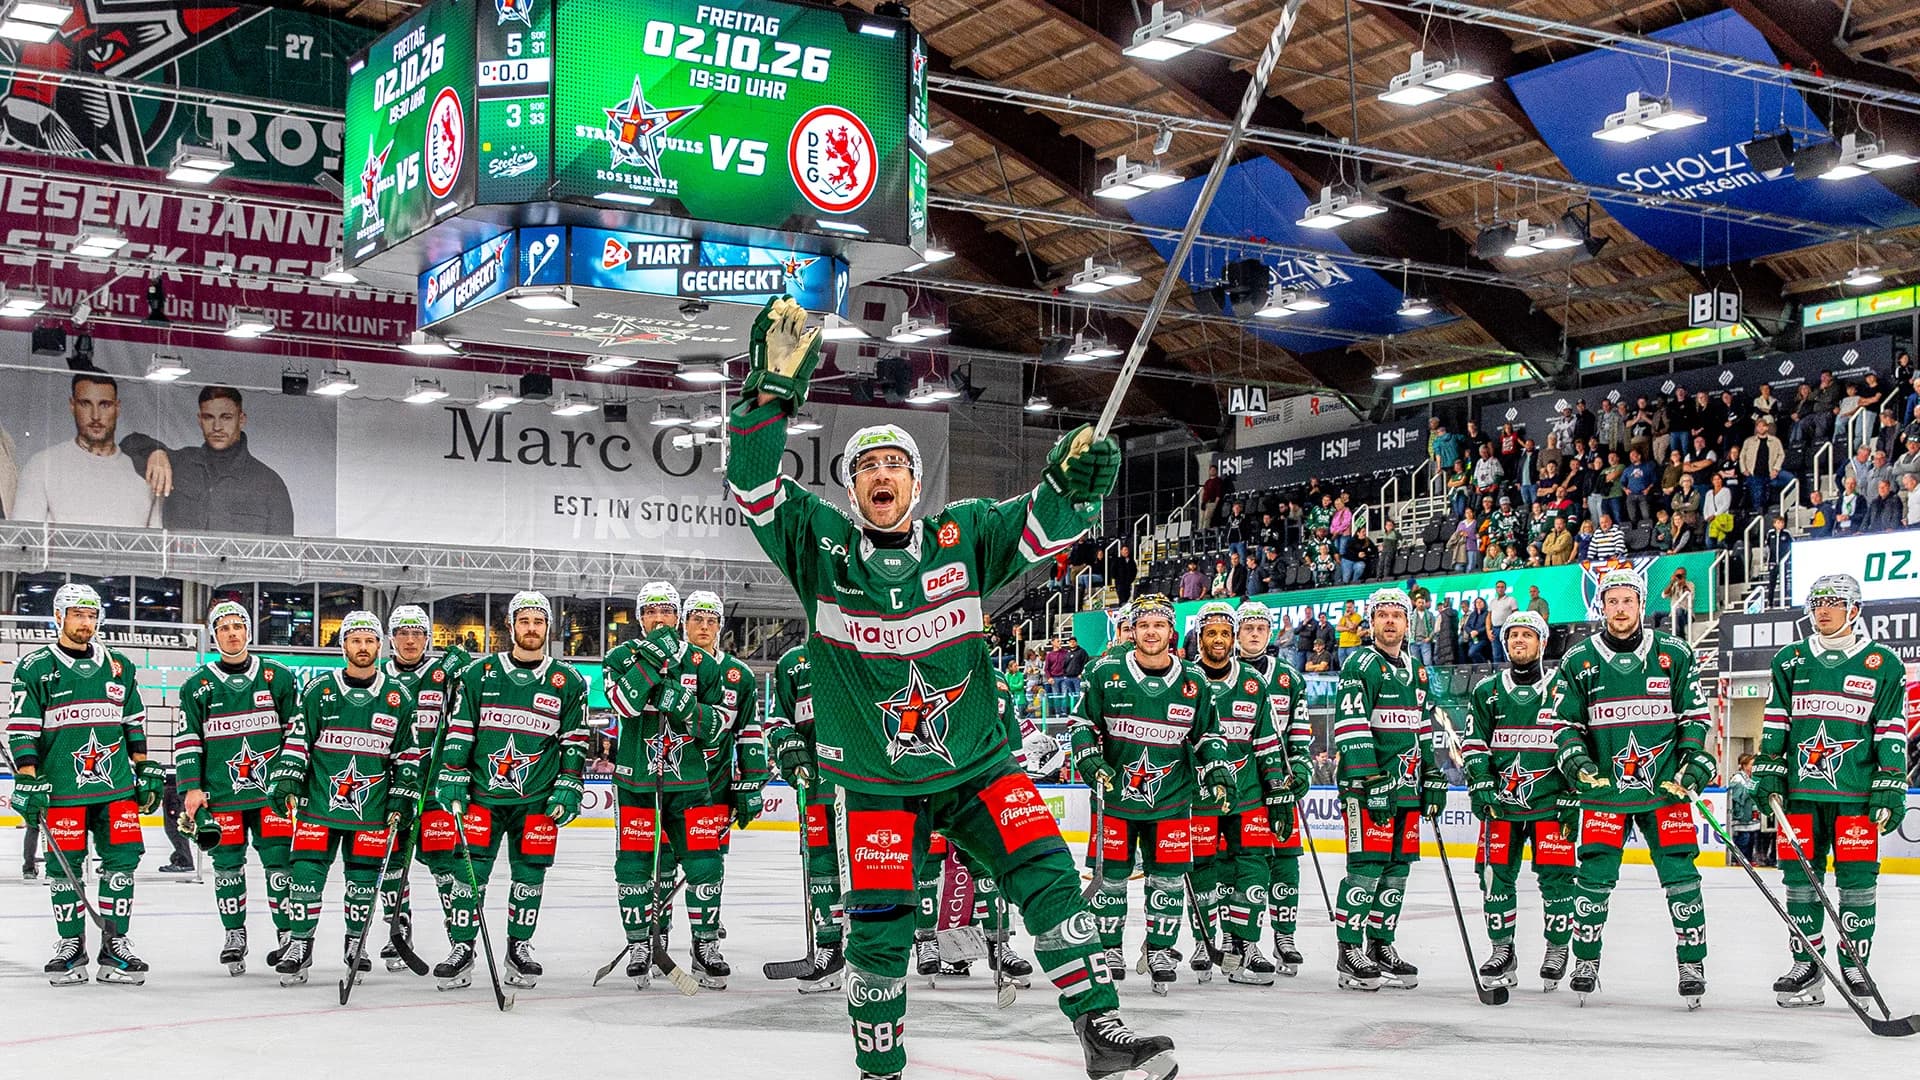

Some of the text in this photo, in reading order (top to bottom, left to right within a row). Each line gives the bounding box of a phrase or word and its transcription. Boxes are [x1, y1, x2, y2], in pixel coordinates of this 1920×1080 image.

[696, 4, 780, 37] FREITAG
[285, 34, 314, 61] 27
[393, 25, 425, 63] FREITAG
[507, 33, 522, 57] 5
[532, 41, 545, 54] 31
[642, 20, 832, 84] 02.10.26
[374, 33, 446, 112] 02.10.26
[689, 68, 787, 100] 19:30 UHR
[506, 104, 522, 127] 3
[530, 112, 545, 126] 33
[708, 134, 768, 176] VS
[396, 152, 420, 195] VS
[1617, 146, 1746, 191] SCHOLZ
[637, 244, 693, 265] HART
[439, 261, 462, 297] HART
[455, 262, 496, 306] GECHECKT
[682, 269, 782, 292] GECHECKT
[1696, 293, 1738, 323] B B
[1230, 386, 1267, 412] A A
[444, 407, 632, 473] Marc
[554, 495, 598, 517] EST.
[609, 499, 630, 519] IN
[1864, 550, 1918, 582] 02.
[890, 588, 903, 609] C
[1341, 692, 1365, 715] 44
[207, 713, 271, 732] vitagroup
[854, 847, 910, 864] Flötzinger
[54, 903, 75, 922] 87
[218, 897, 238, 915] 48
[350, 904, 369, 922] 63
[517, 908, 536, 926] 18
[622, 907, 642, 924] 71
[1279, 906, 1296, 921] 26
[452, 910, 469, 927] 18
[1100, 917, 1119, 934] 17
[1157, 918, 1177, 936] 17
[1581, 924, 1603, 943] 37
[1688, 925, 1706, 944] 37
[1089, 951, 1112, 984] 5
[857, 1021, 894, 1053] 58
